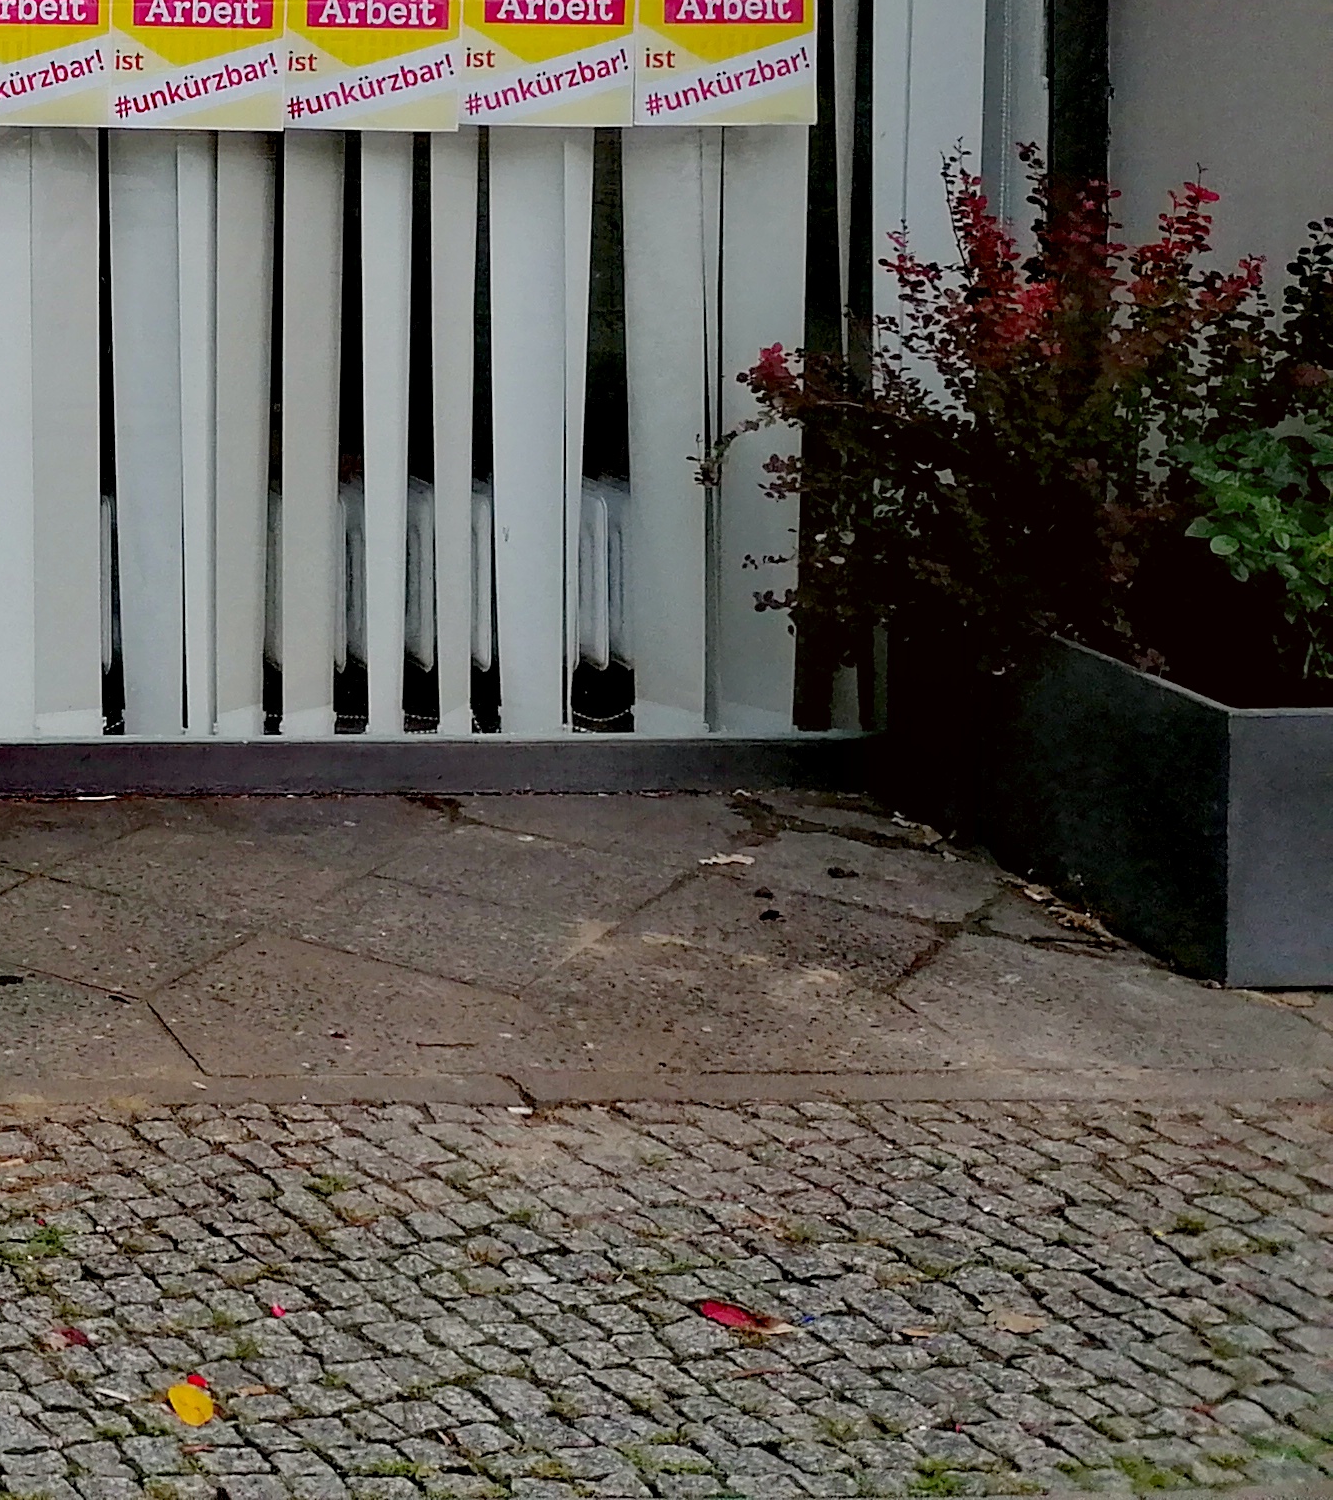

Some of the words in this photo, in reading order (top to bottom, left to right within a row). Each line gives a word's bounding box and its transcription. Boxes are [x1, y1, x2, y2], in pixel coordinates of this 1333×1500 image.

[115, 49, 145, 71] ist
[288, 50, 318, 72] ist
[466, 46, 496, 69] ist
[645, 47, 676, 69] ist
[114, 52, 278, 119] #unkürzbar!
[286, 53, 455, 121] #unkürzbar!
[464, 48, 630, 117] #unkürzbar!
[645, 46, 810, 117] #unkürzbar!
